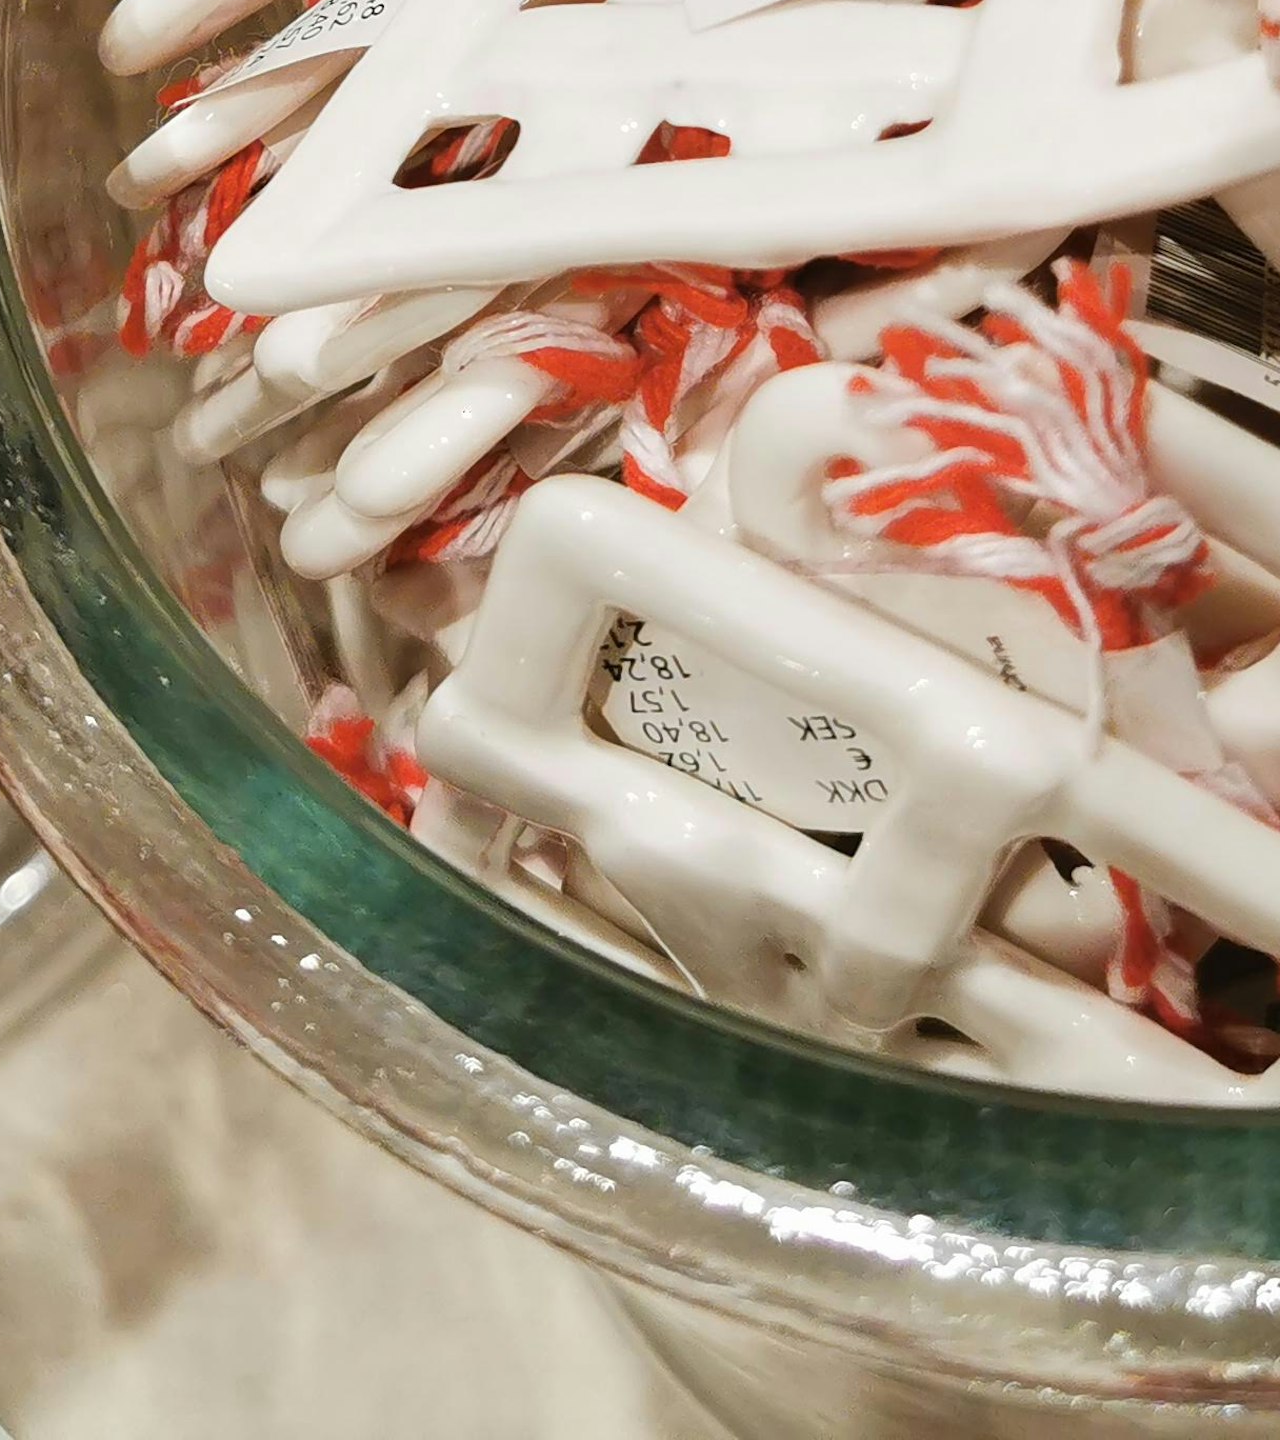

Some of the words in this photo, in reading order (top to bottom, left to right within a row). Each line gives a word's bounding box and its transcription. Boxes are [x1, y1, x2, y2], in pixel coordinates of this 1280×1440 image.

[602, 654, 692, 682] 18,24
[629, 690, 690, 714] 1,57
[643, 719, 730, 744] 18,40
[787, 716, 857, 742] SEK
[660, 750, 726, 773] 1,62
[846, 748, 872, 771] €
[815, 779, 889, 803] DKK
